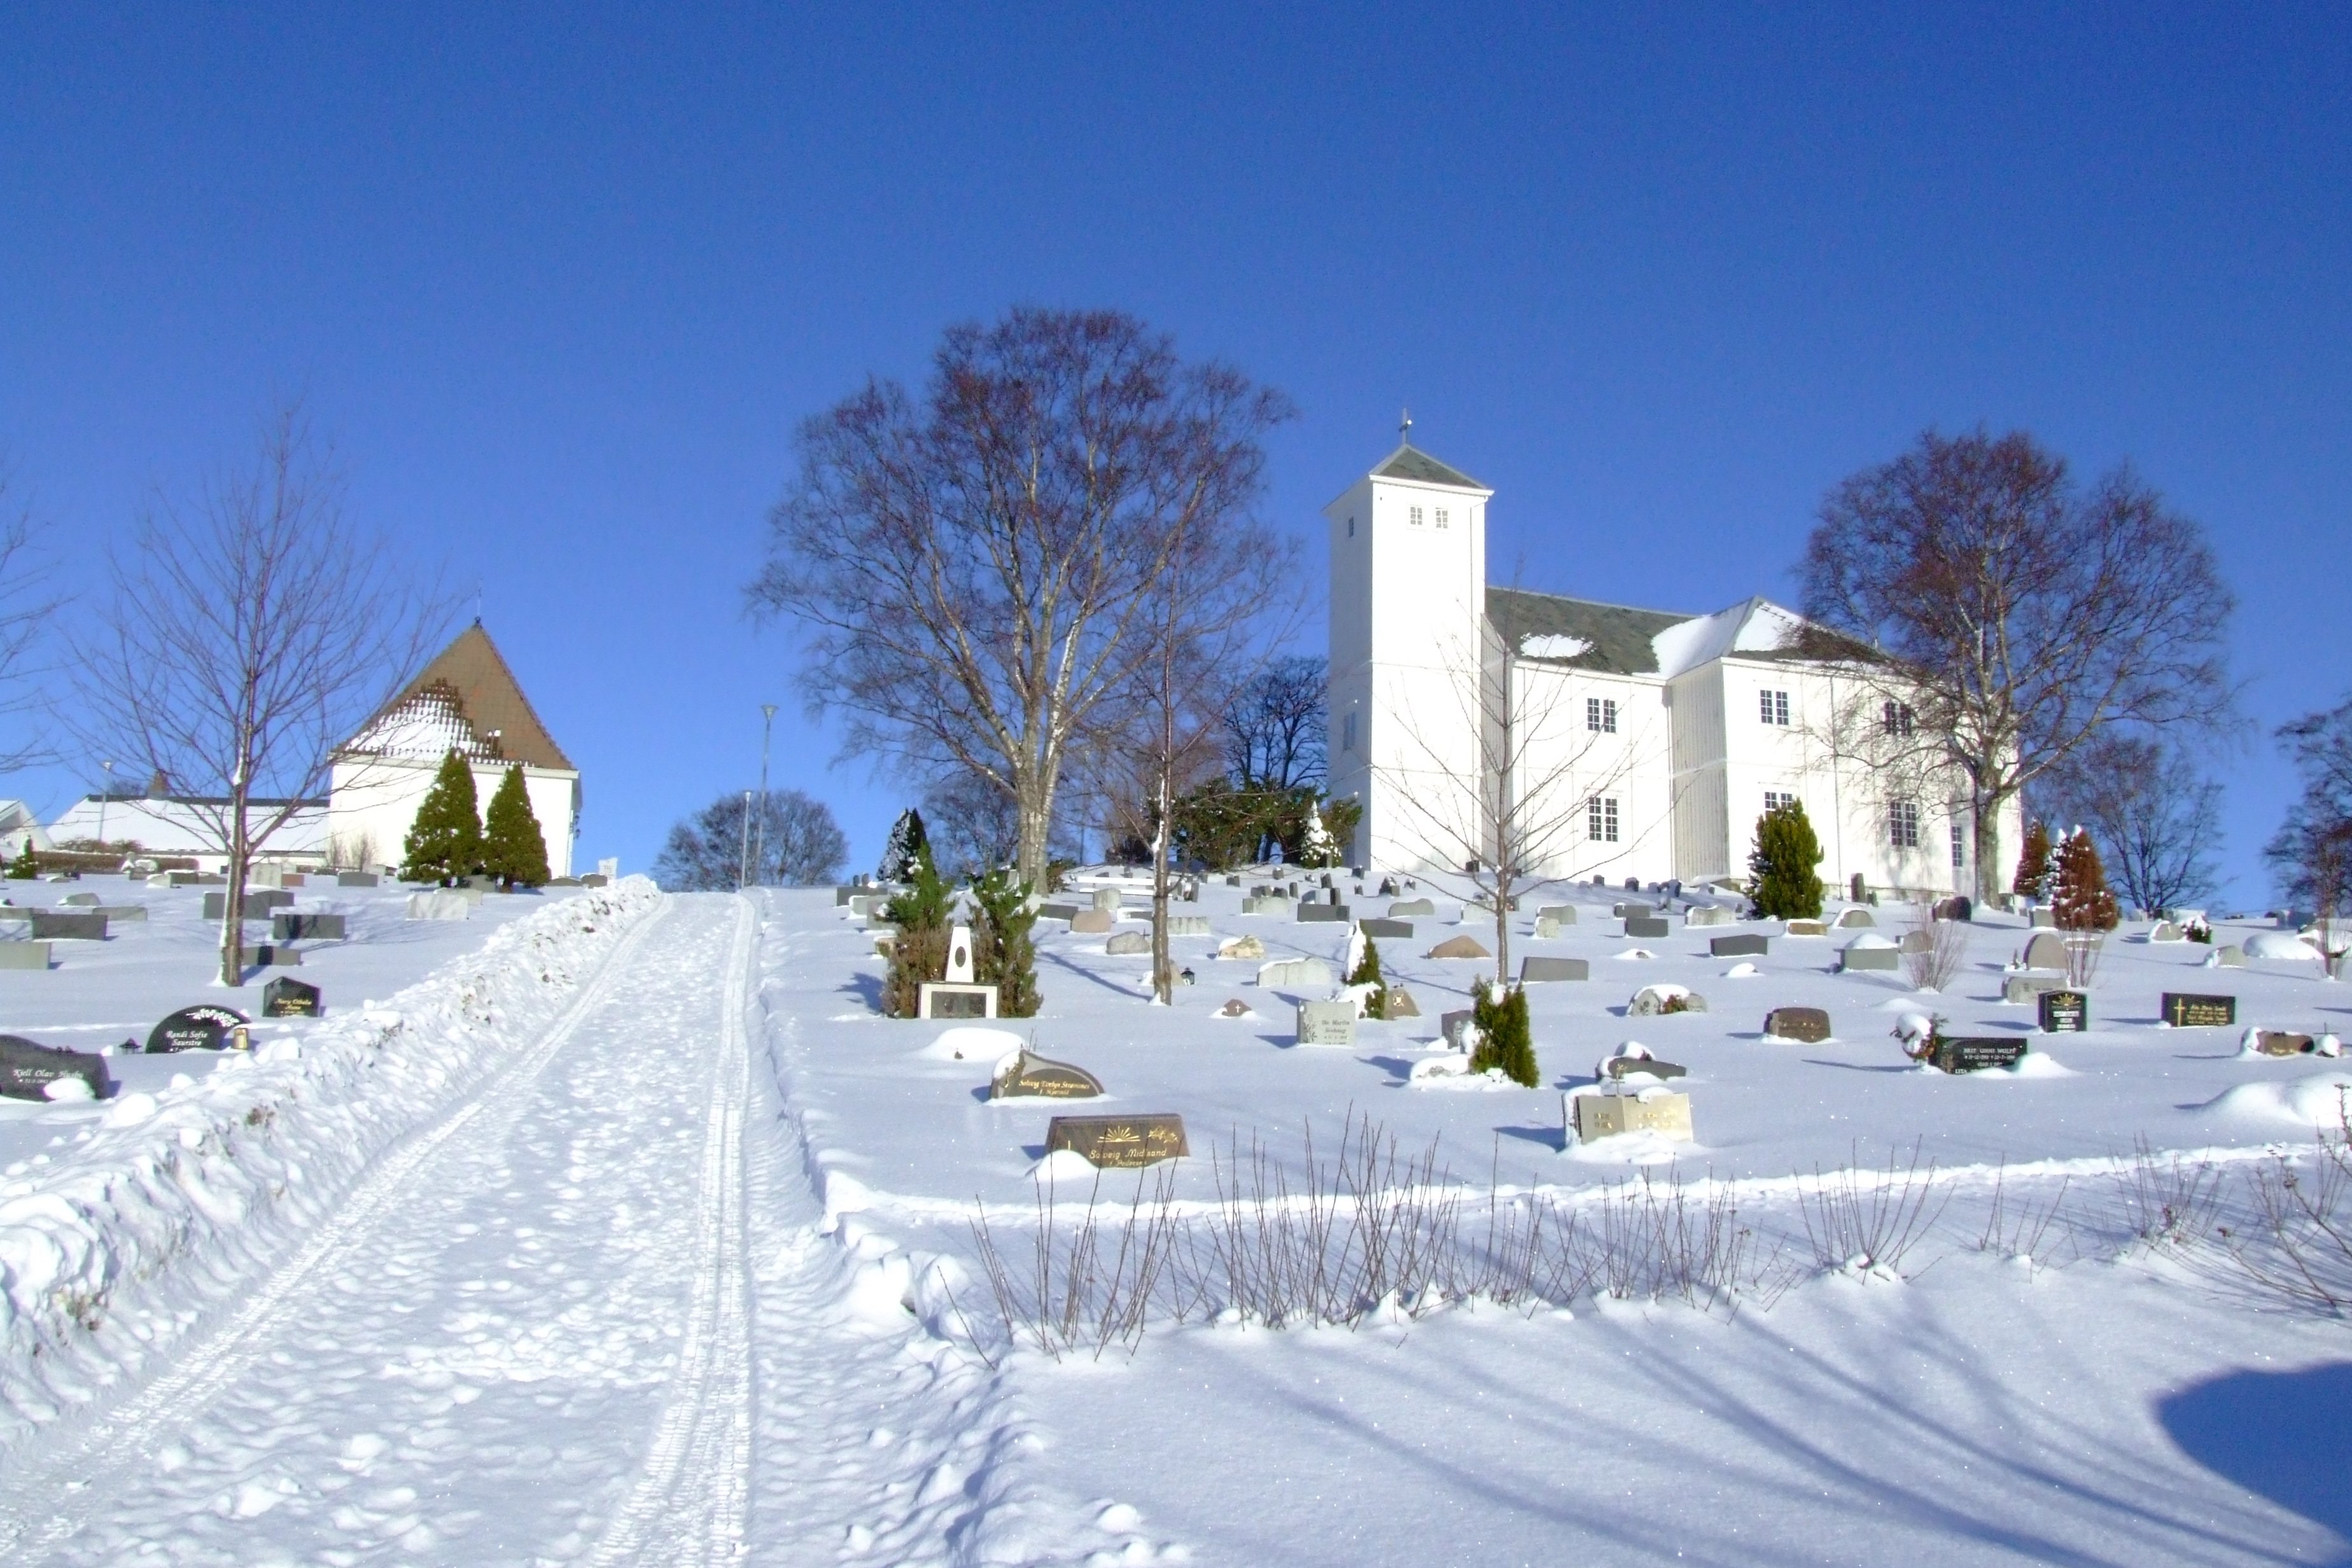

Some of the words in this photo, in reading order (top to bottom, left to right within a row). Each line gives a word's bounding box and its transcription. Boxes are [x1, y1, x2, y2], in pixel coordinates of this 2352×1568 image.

[165, 1030, 188, 1039] Randi
[13, 1068, 34, 1078] Kjell
[35, 1069, 55, 1077] Olav
[1089, 1149, 1121, 1159] Soveig
[1125, 1147, 1167, 1158] Midsand
